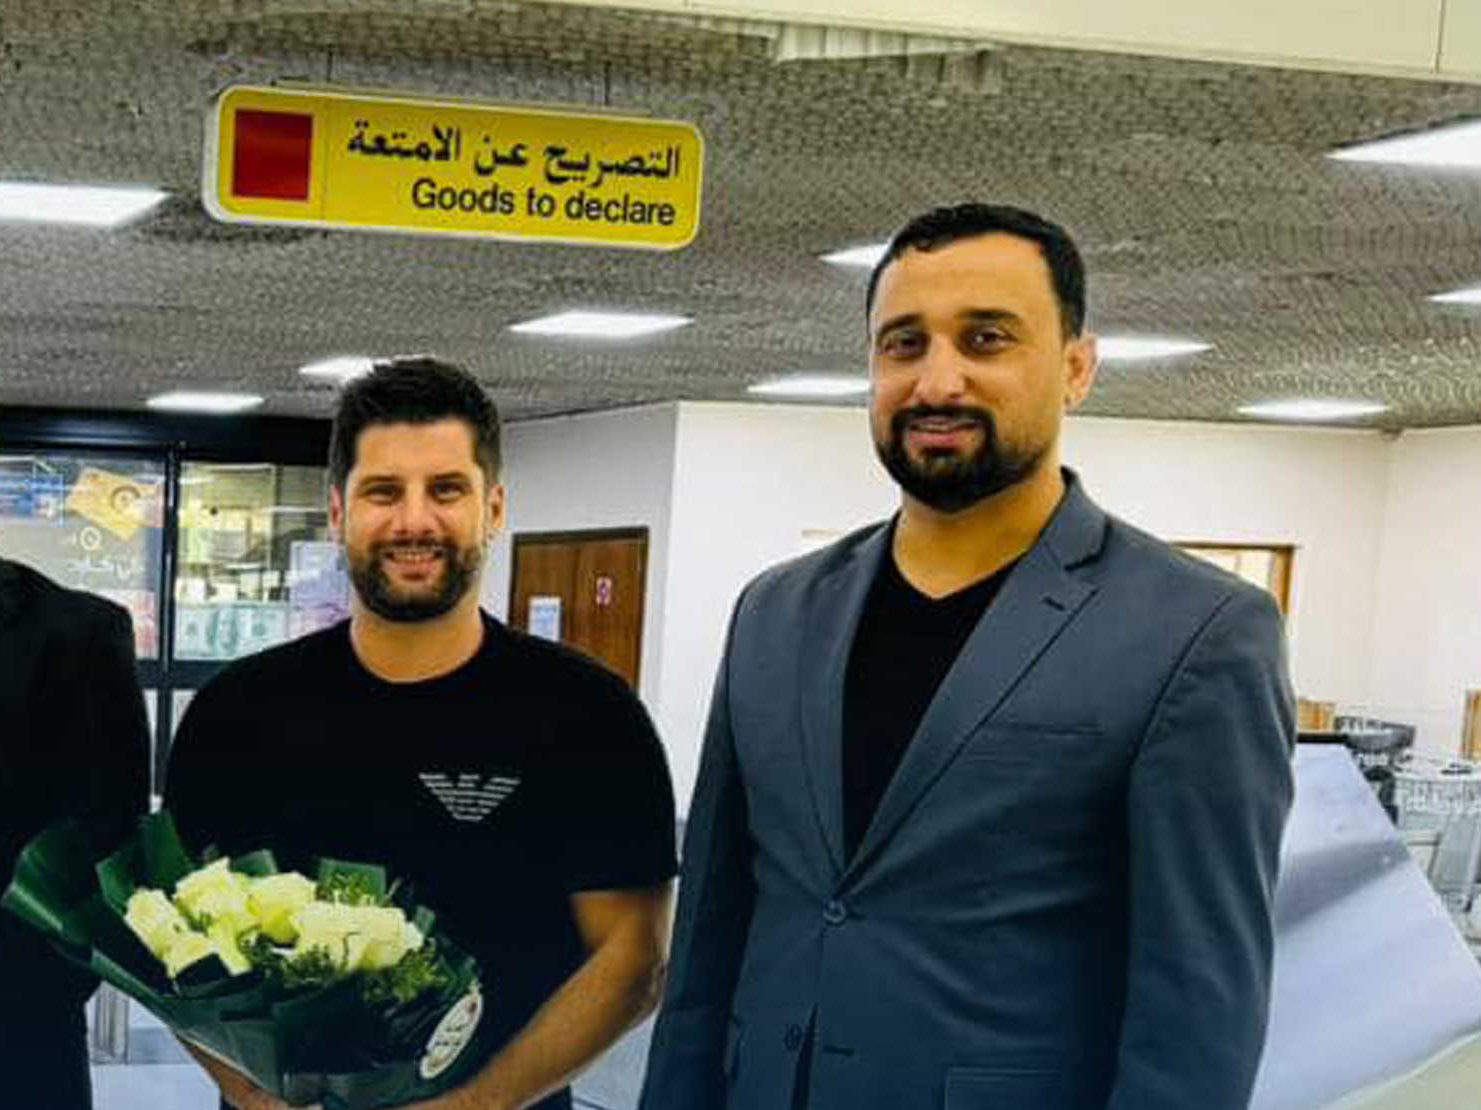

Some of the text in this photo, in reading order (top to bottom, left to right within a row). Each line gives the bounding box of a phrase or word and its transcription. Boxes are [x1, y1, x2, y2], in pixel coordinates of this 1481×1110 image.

[474, 136, 529, 175] عن
[543, 145, 680, 187] التصريح
[411, 177, 676, 226] Goods to declare
